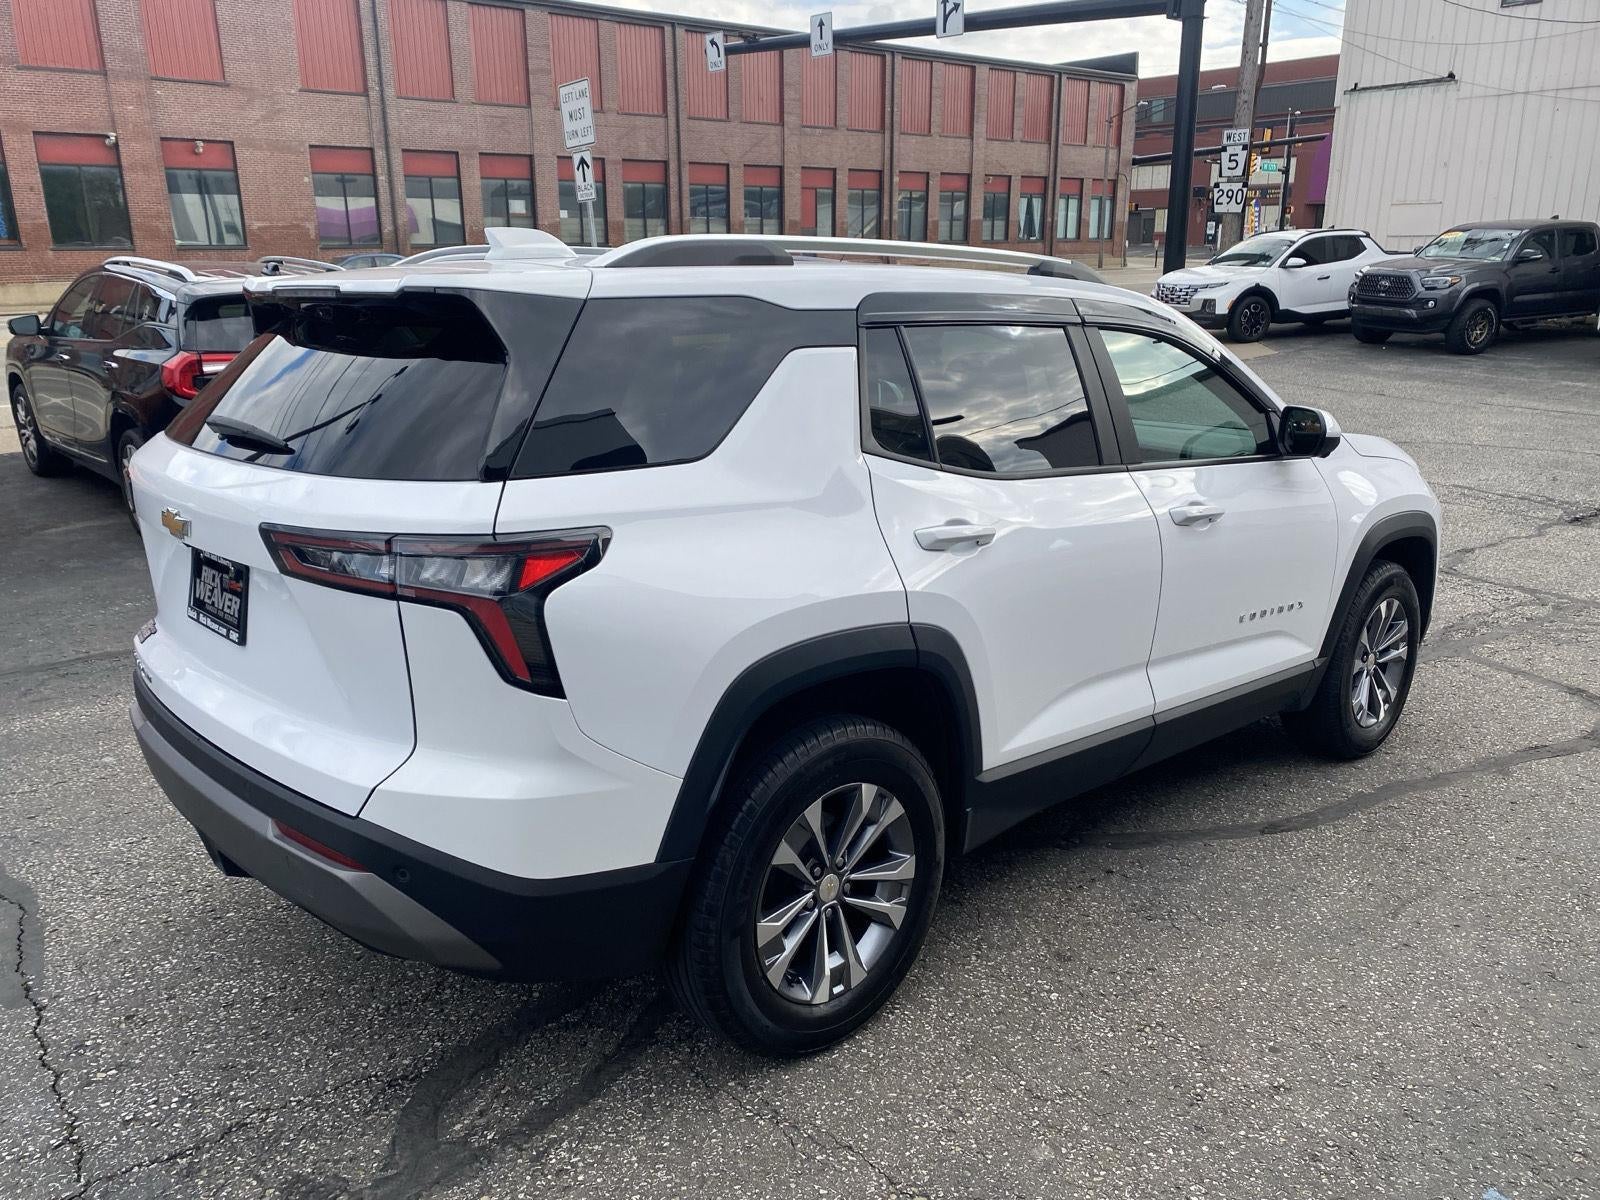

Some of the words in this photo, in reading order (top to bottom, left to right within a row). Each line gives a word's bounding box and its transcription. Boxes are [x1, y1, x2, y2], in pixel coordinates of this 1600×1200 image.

[814, 41, 829, 52] ONLY
[710, 60, 722, 69] ONLY
[562, 92, 573, 104] LEFT
[575, 88, 588, 100] LANE
[568, 107, 584, 122] MUST
[566, 129, 579, 140] TURN
[580, 125, 592, 137] LEFT
[1226, 132, 1247, 142] WEST
[1227, 153, 1239, 170] 5
[577, 183, 593, 192] BLACK
[1215, 188, 1244, 205] 290
[201, 565, 222, 588] RICK
[196, 578, 240, 618] WEAVER
